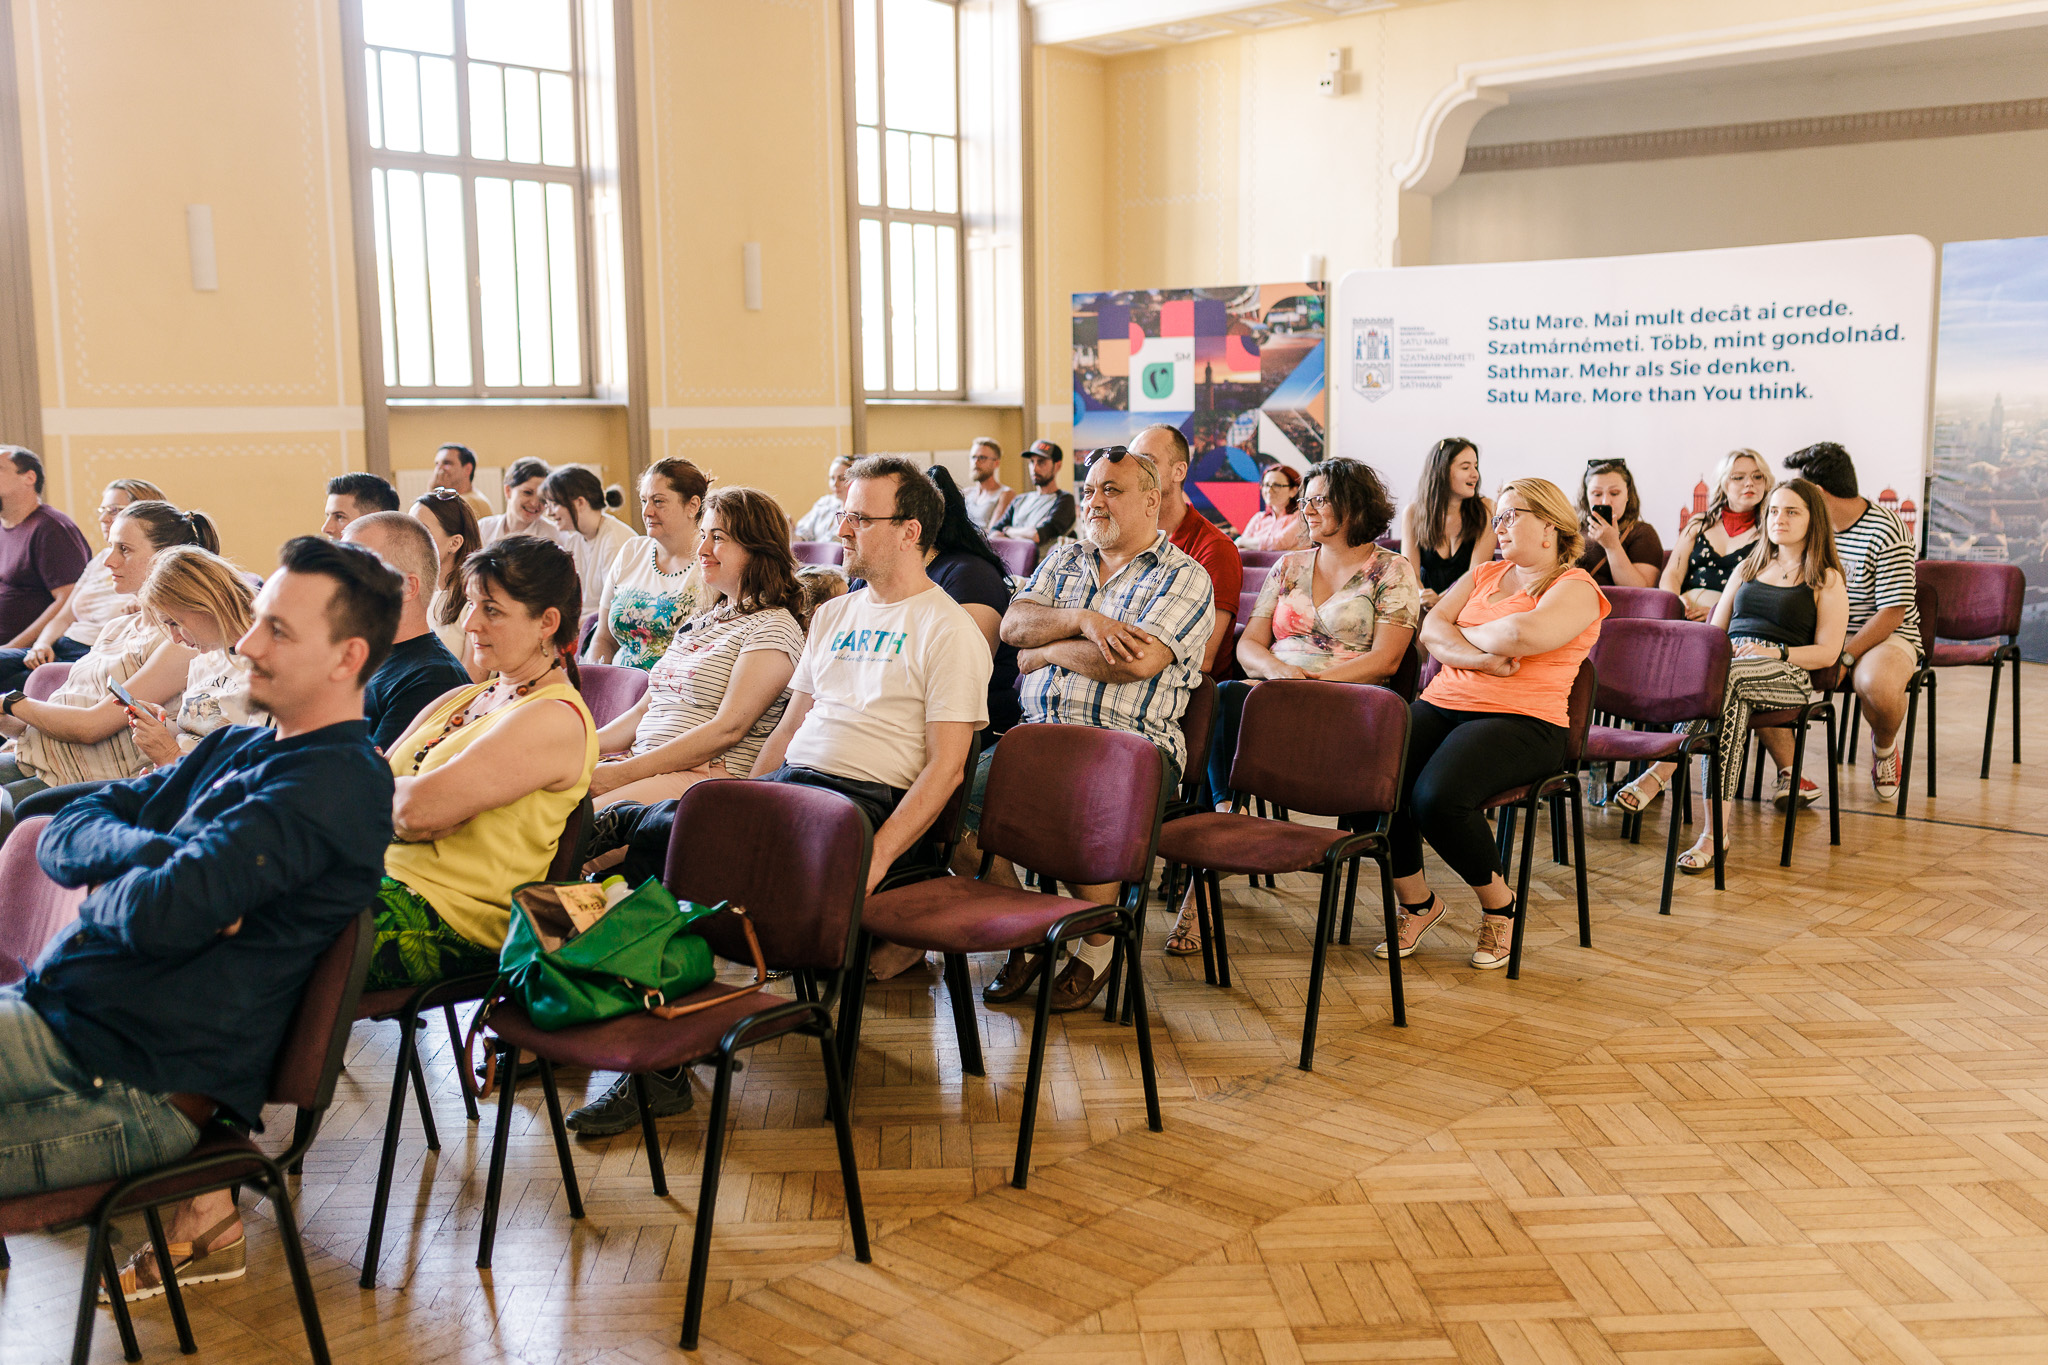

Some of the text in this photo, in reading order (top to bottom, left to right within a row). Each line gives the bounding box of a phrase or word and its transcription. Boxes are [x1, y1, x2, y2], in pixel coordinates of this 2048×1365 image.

[1487, 298, 1853, 331] Satu Mare. Mai mult decât ai crede.
[1487, 322, 1905, 356] Szatmárnémeti. Több, mint gondolnád.
[1487, 356, 1795, 380] Sathmar. Mehr als Sie denken.
[1487, 381, 1814, 404] Satu Mare. More than You think.
[830, 629, 908, 655] EARTH
